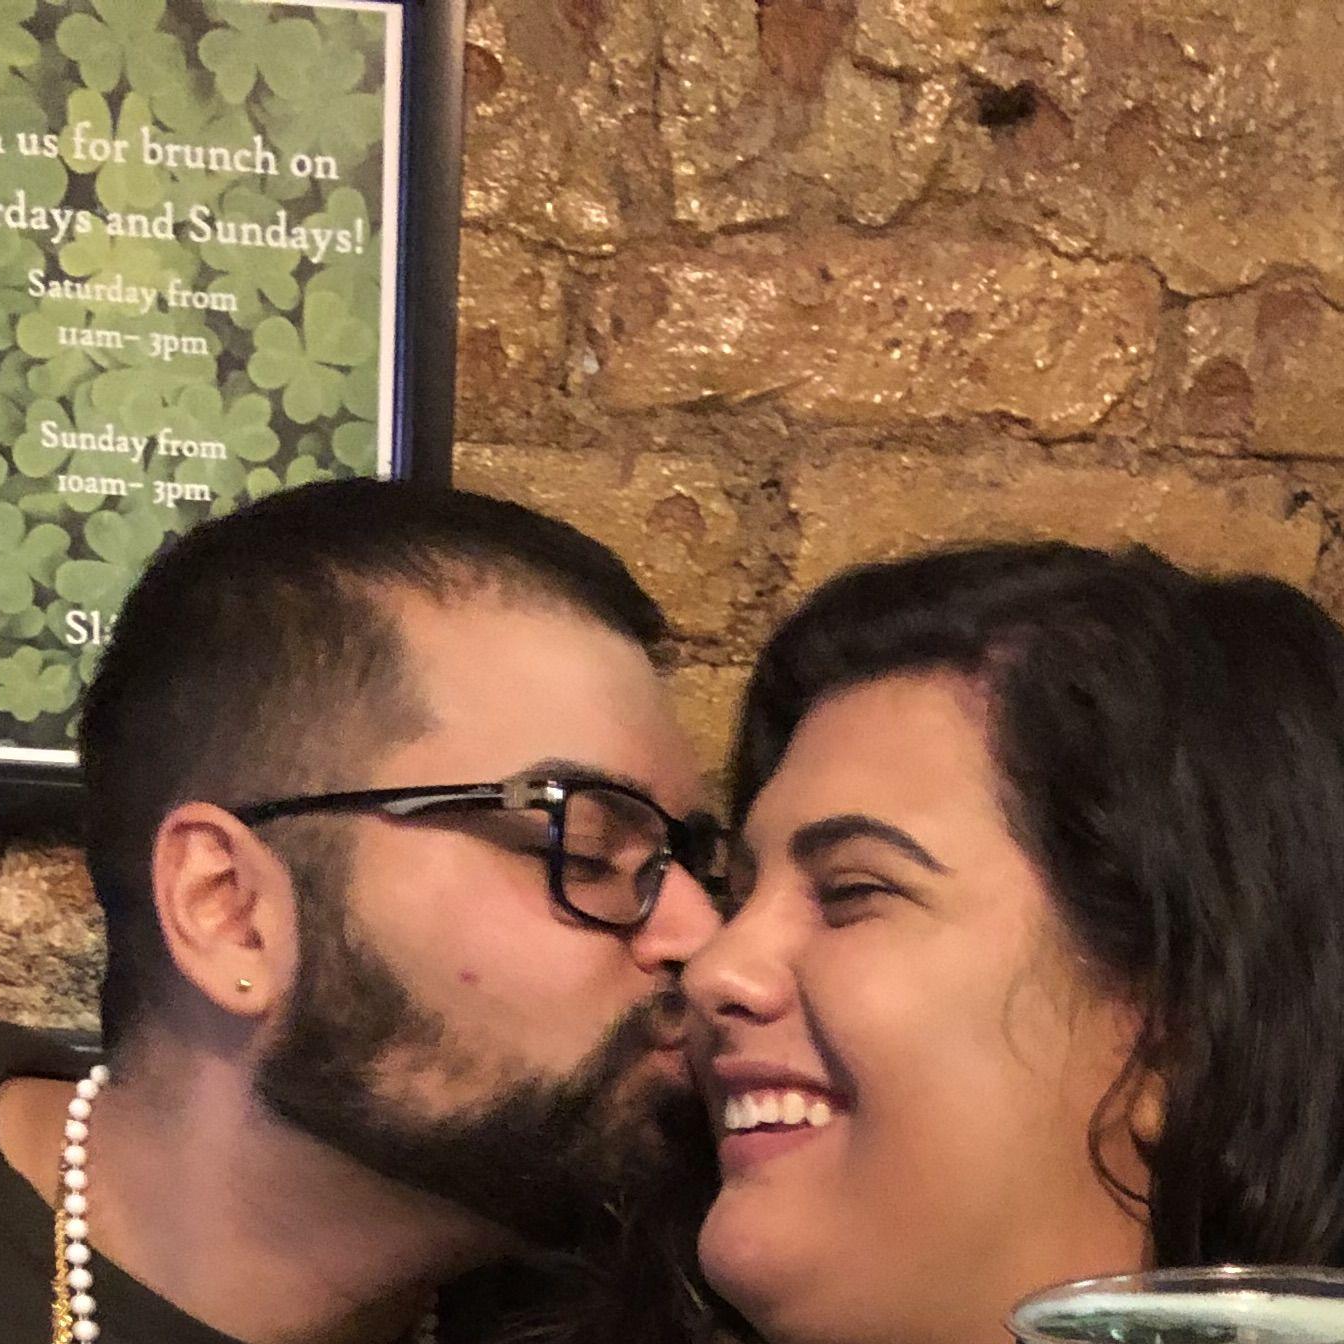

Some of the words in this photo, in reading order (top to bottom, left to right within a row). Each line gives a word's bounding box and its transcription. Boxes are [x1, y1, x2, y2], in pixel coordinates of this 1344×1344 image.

[17, 132, 60, 158] us
[72, 121, 129, 163] for
[140, 126, 279, 175] brunch
[290, 152, 340, 180] on
[106, 201, 175, 240] and
[188, 204, 364, 264] Sundays!
[27, 268, 157, 314] Saturday
[167, 279, 238, 312] from
[148, 331, 208, 362] 3pm
[40, 420, 149, 462] Sunday
[156, 427, 227, 460] from
[152, 480, 211, 508] 3pm
